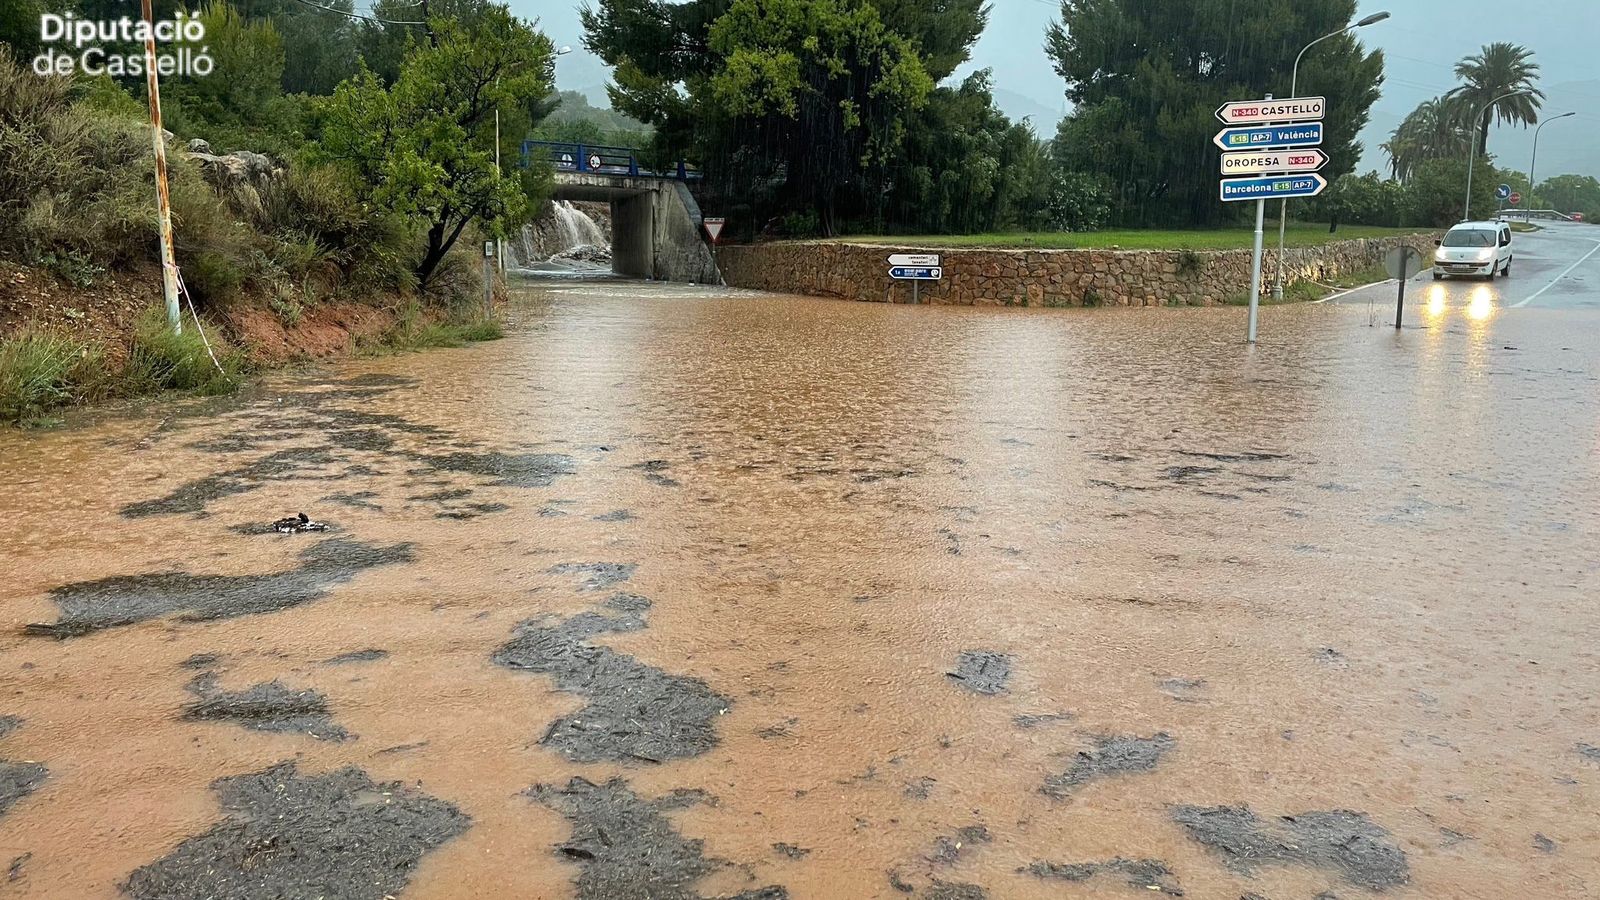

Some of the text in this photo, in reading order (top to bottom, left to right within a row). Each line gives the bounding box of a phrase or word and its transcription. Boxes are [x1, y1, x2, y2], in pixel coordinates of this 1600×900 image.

[1232, 103, 1321, 117] N-340 CASTELLÓ
[1231, 131, 1319, 143] E-15 AP-7 València
[1225, 156, 1314, 167] OROPESA N-340
[1225, 183, 1271, 194] Barcelona
[1274, 182, 1290, 190] E-15
